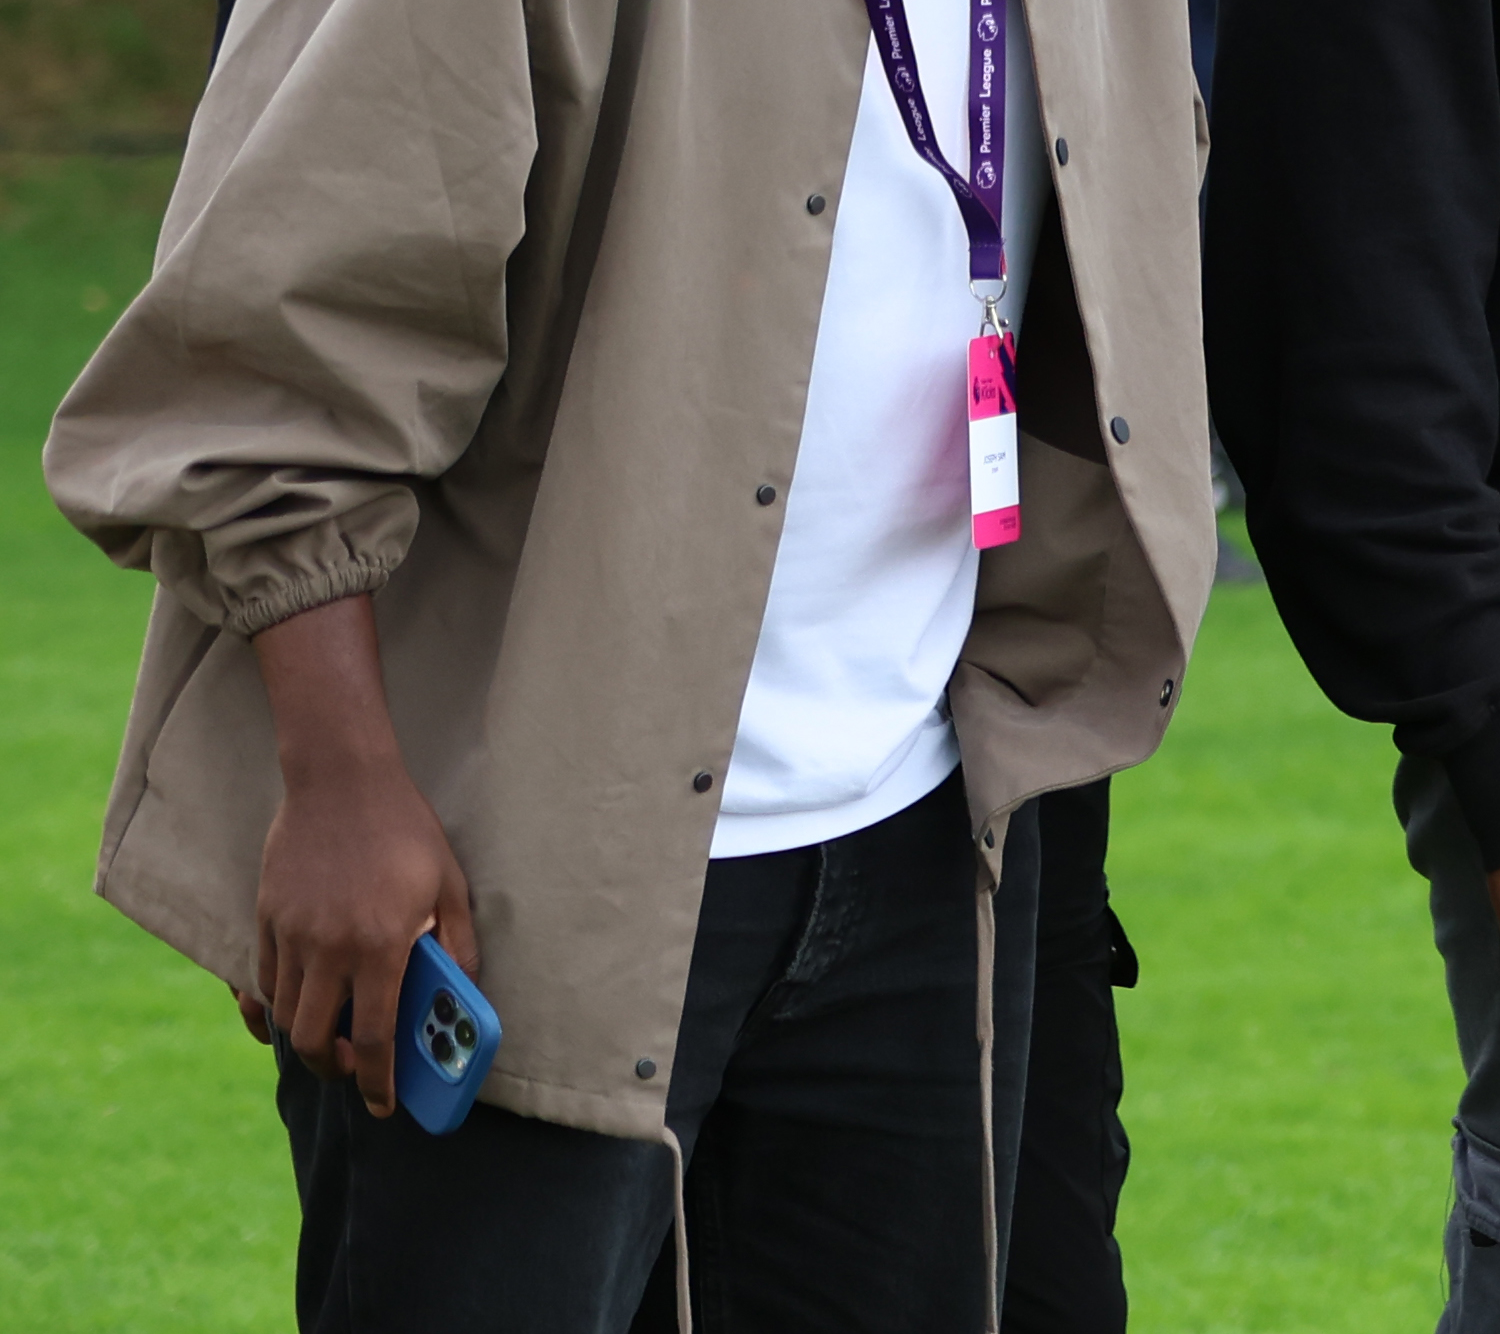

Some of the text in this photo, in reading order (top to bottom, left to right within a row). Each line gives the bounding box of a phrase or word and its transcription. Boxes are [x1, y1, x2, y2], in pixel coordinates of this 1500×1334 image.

[884, 14, 903, 60] Premier
[979, 48, 994, 154] Premier League
